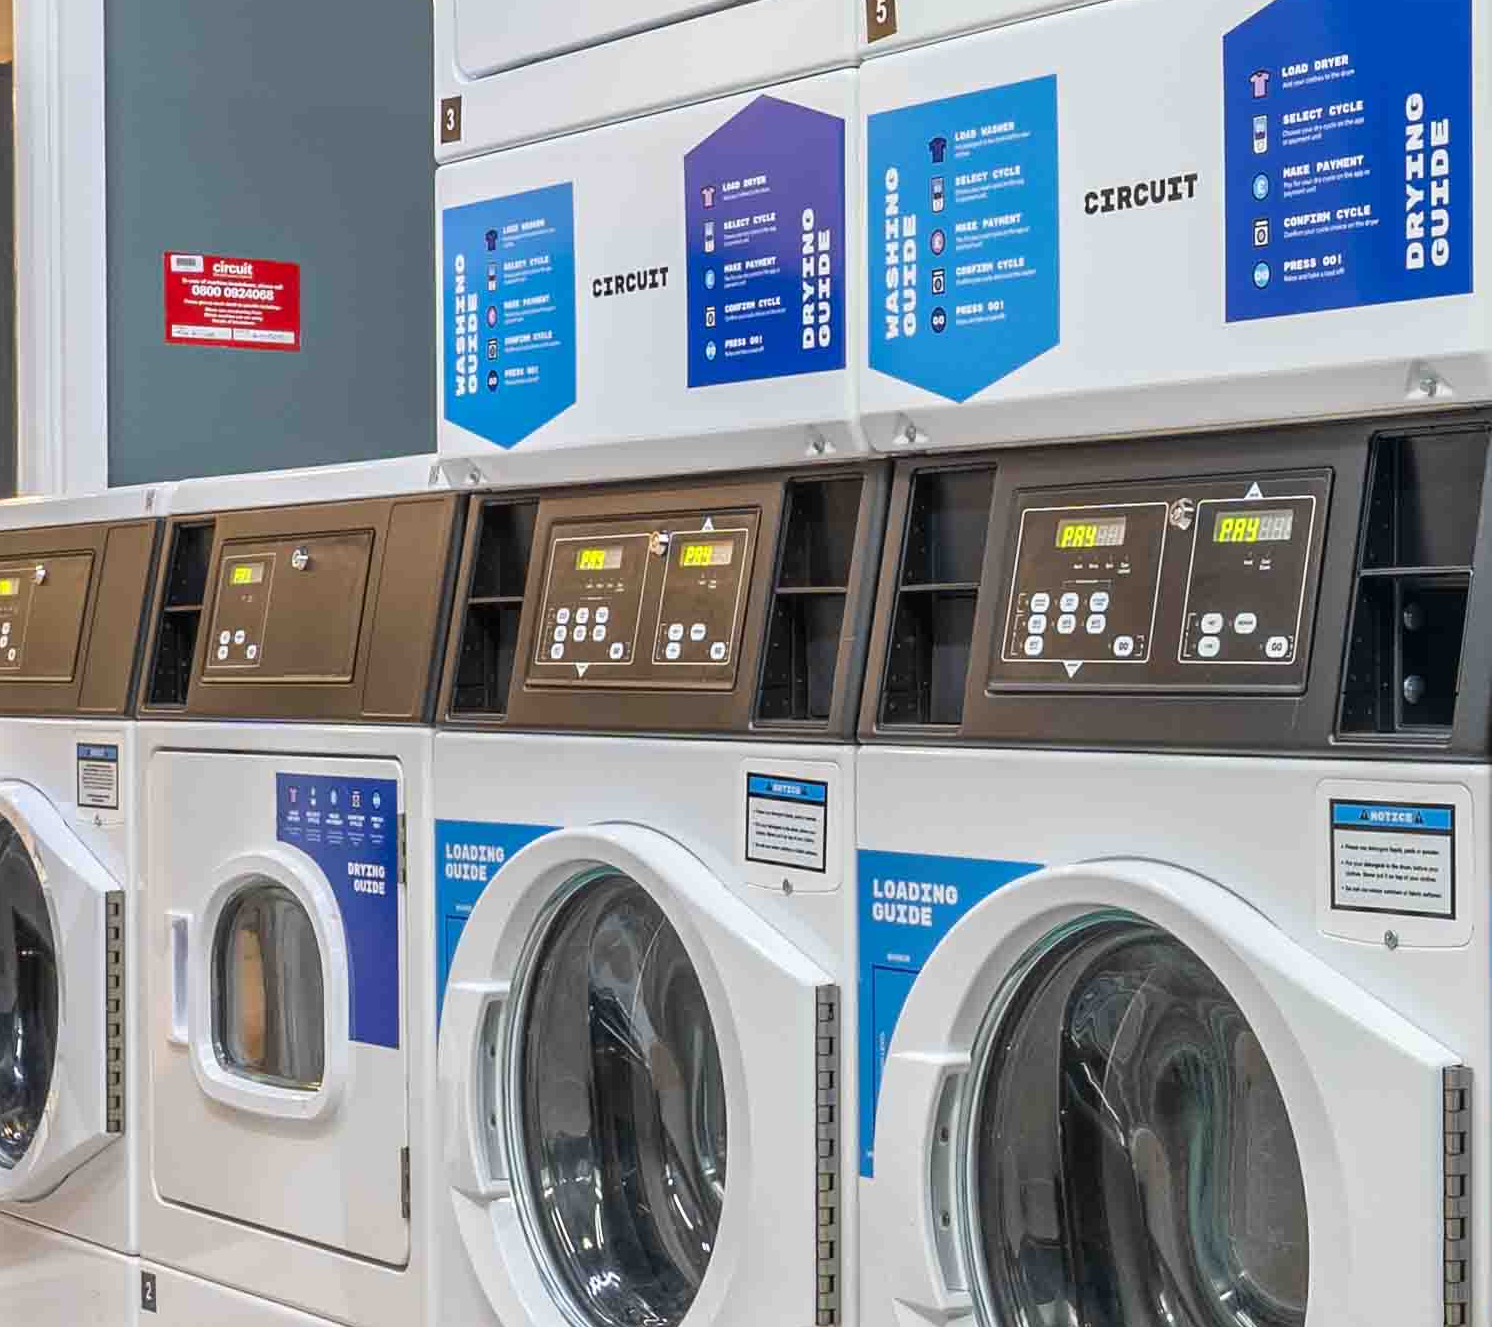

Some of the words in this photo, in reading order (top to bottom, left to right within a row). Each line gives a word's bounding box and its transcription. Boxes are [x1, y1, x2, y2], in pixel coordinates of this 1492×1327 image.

[447, 108, 454, 130] 3
[1406, 93, 1424, 269] DRYING
[1431, 118, 1449, 266] GUIDE
[1084, 173, 1198, 215] CIRCUIT
[213, 261, 253, 274] circuit
[592, 266, 669, 298] CIRCUIT
[445, 844, 505, 863] LOADING
[445, 863, 487, 882] GUIDE
[873, 879, 958, 905] LOADING
[872, 902, 933, 927] GUIDE
